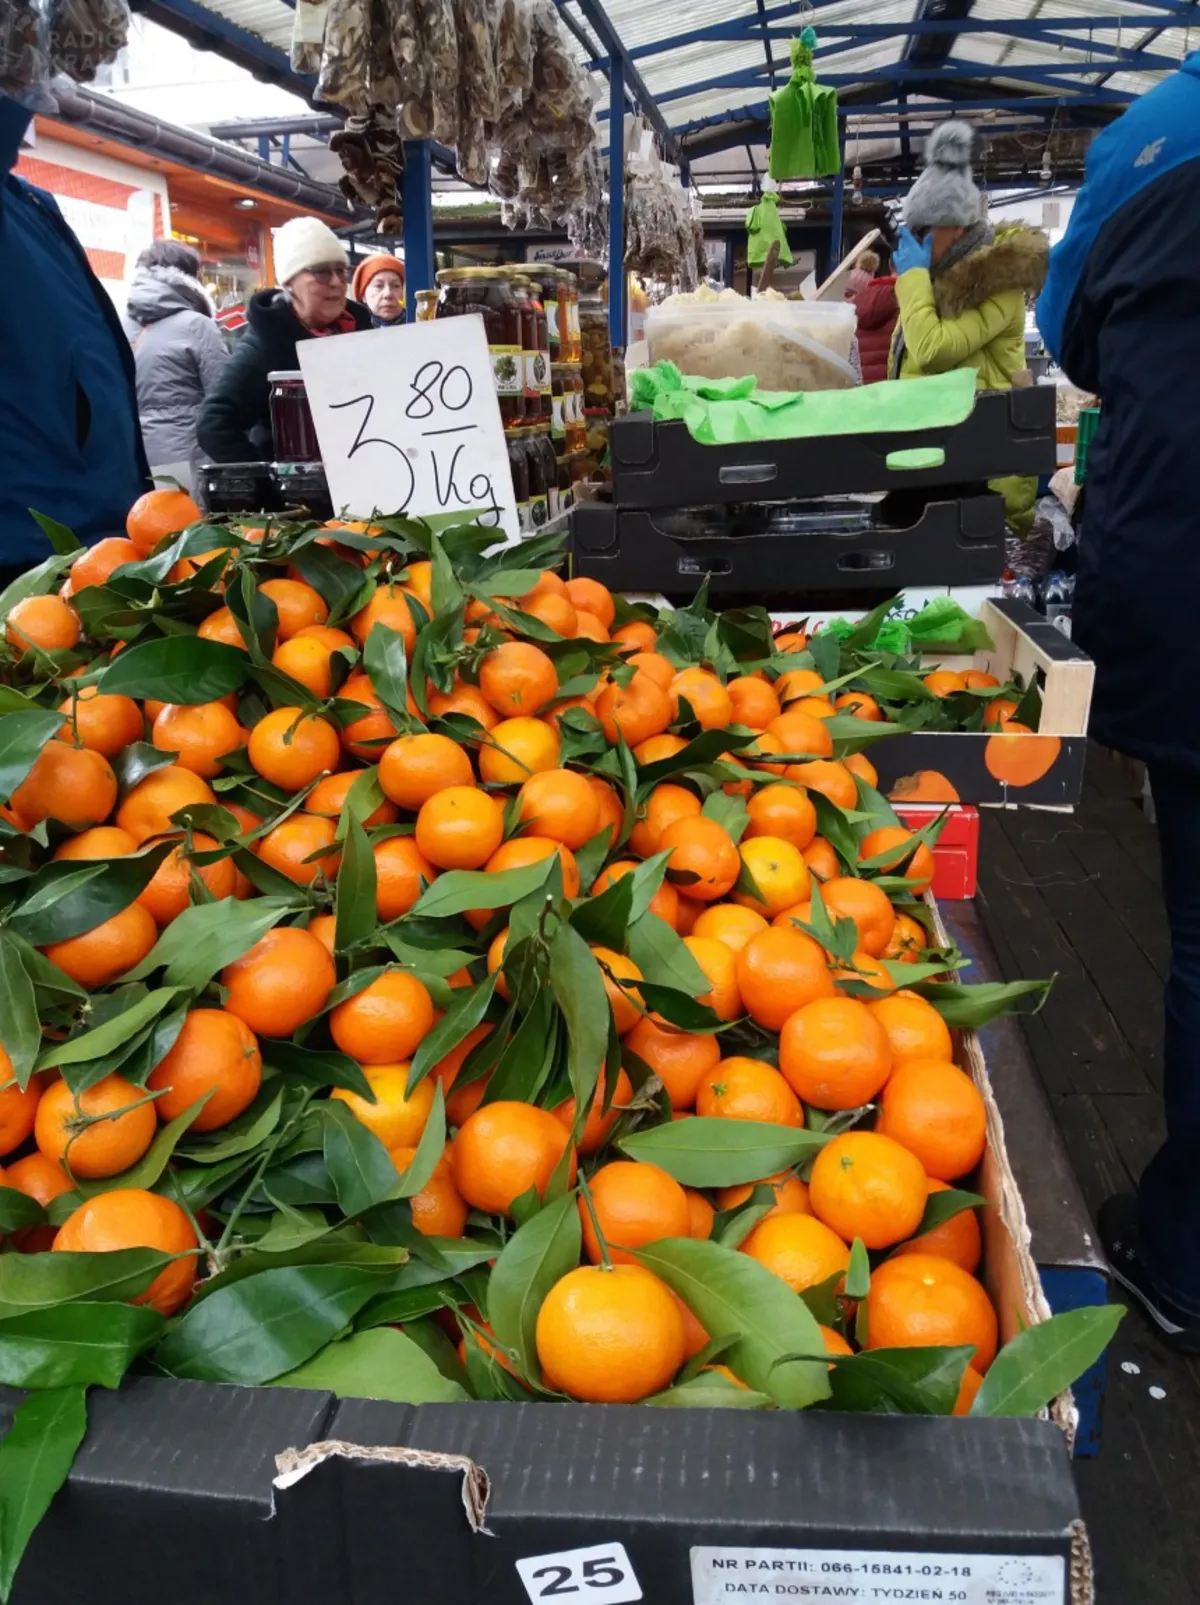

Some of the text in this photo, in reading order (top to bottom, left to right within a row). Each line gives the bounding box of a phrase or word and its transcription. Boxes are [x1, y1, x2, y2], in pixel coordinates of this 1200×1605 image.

[329, 361, 473, 514] 3 80
[532, 1557, 625, 1597] 25
[712, 1559, 738, 1569] NR
[745, 1560, 814, 1572] PARTII:
[725, 1583, 770, 1593] DATA
[775, 1585, 865, 1597] DOSTAWY:
[950, 1591, 967, 1601] 50
